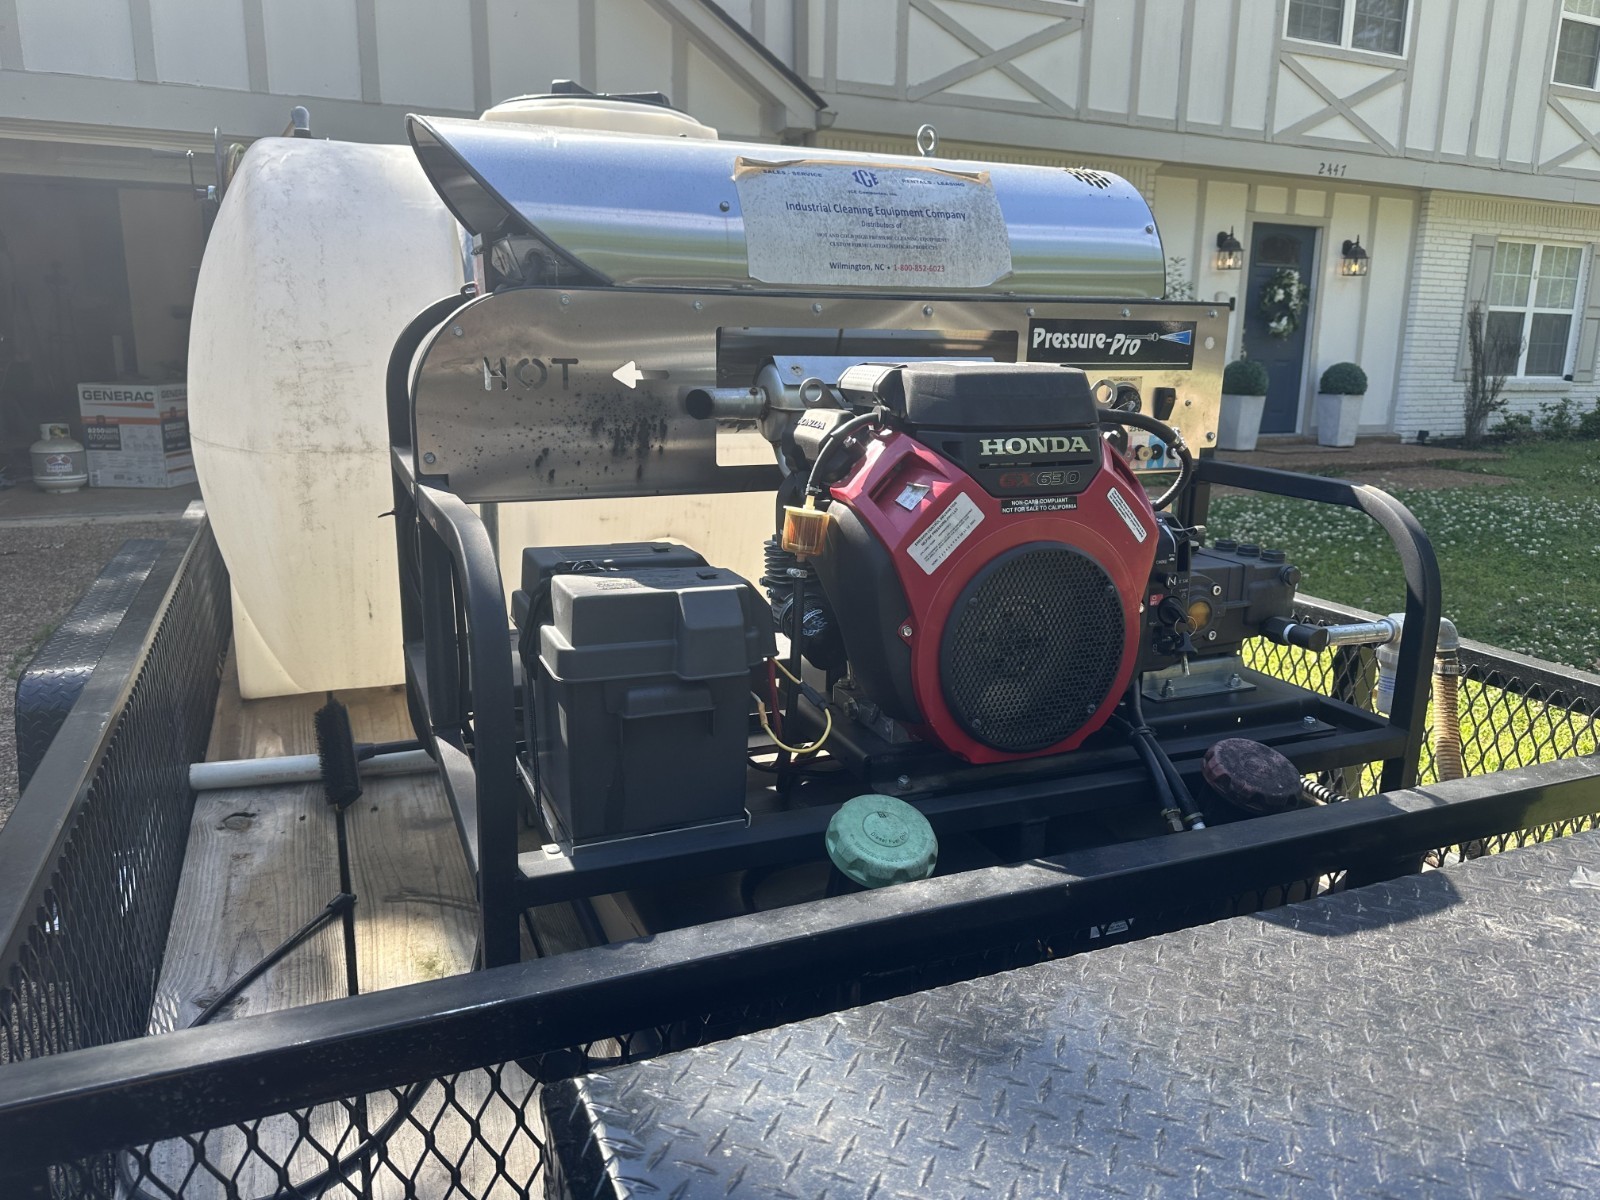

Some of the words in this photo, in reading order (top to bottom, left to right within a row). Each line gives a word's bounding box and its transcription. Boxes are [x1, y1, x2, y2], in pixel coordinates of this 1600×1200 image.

[785, 201, 832, 213] Industrial
[833, 203, 874, 217] Cleaning
[875, 206, 924, 219] Equipment
[925, 208, 966, 221] Company
[861, 220, 895, 229] Distributors
[829, 261, 873, 272] Wilmington,
[874, 263, 885, 271] NC
[1032, 327, 1142, 356] Pressure-Pro
[482, 356, 579, 391] HOT
[82, 389, 154, 402] GENERAC
[979, 436, 1091, 456] HONDA
[1047, 503, 1077, 511] CALIFORNIA
